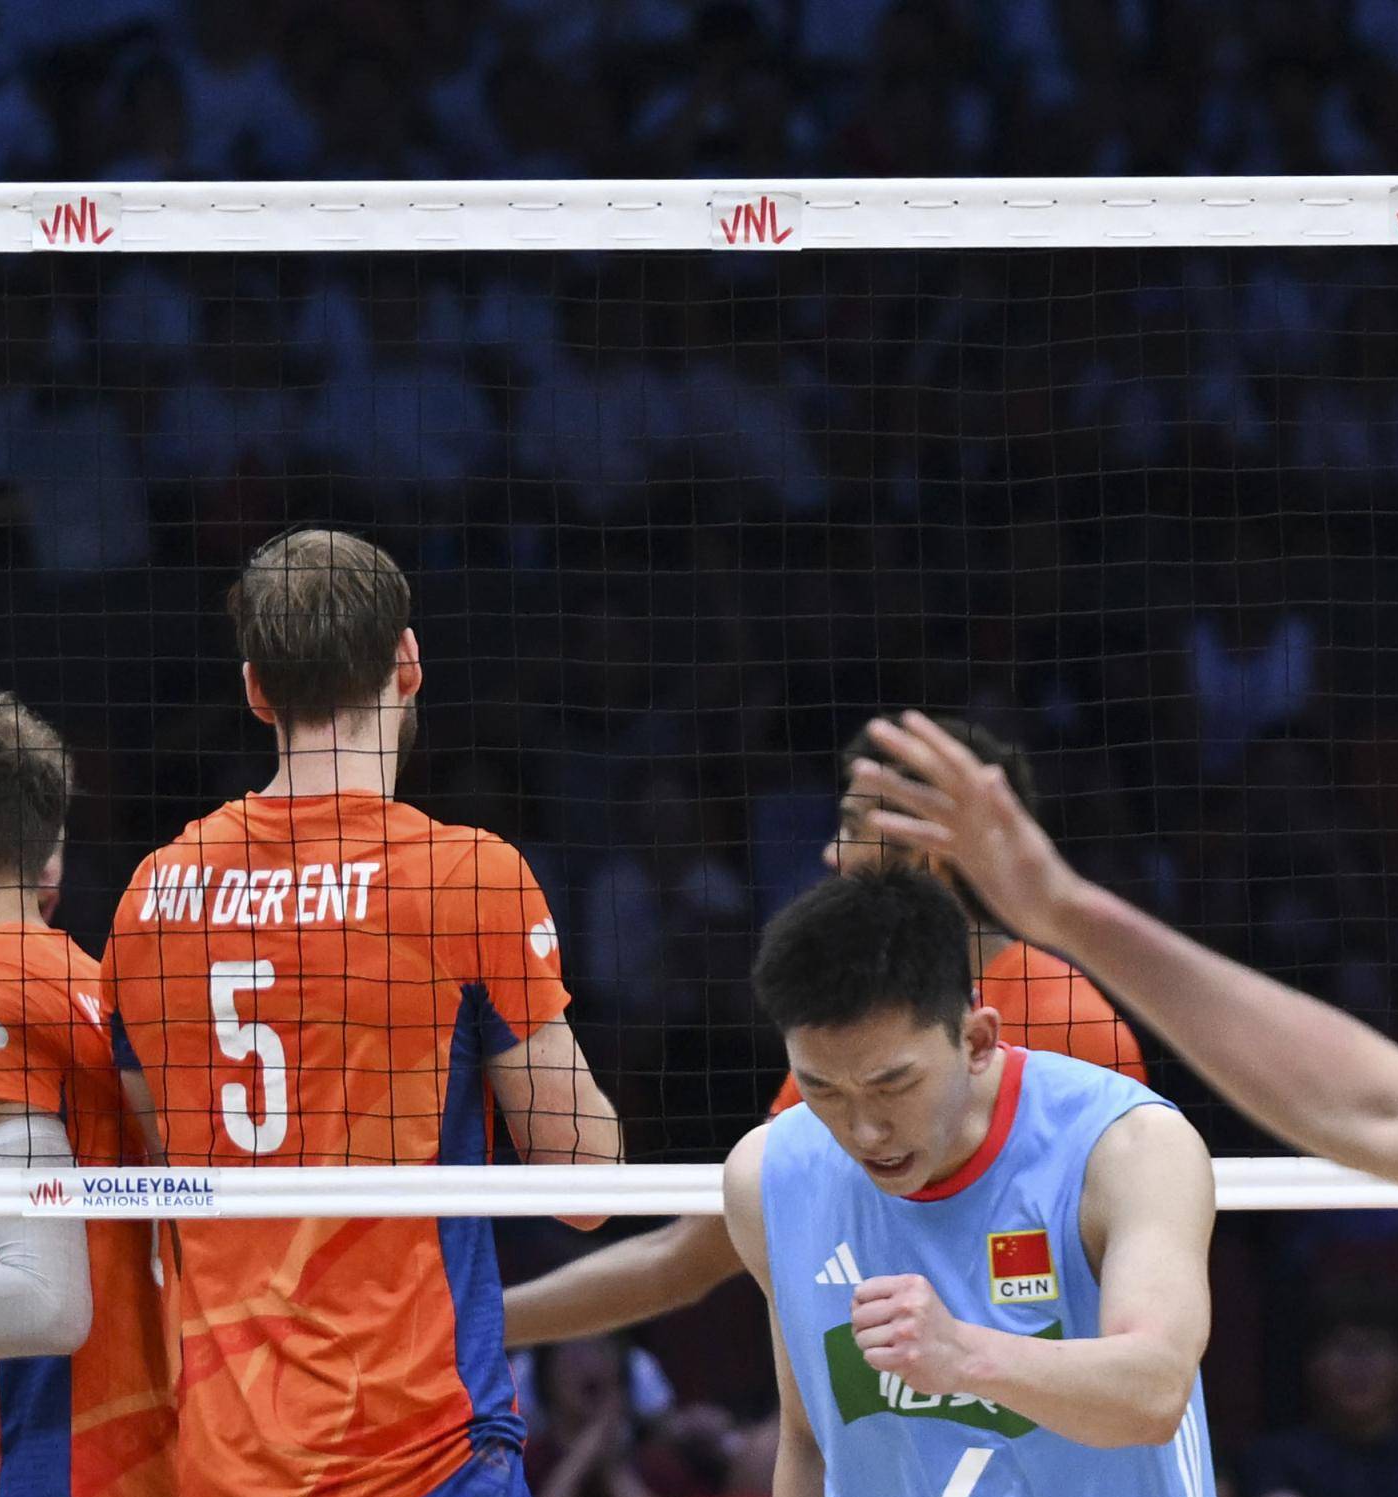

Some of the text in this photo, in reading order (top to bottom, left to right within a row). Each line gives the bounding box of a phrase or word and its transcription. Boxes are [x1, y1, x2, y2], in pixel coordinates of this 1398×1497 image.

[39, 196, 114, 245] VNL
[719, 196, 794, 244] VNL
[139, 862, 380, 925] VAN DER ENT
[209, 959, 288, 1154] 5
[29, 1178, 73, 1206] VNL
[83, 1178, 213, 1193] VOLLEYBALL
[83, 1195, 213, 1207] NATIONS LEAGUE
[1000, 1279, 1048, 1297] CHN
